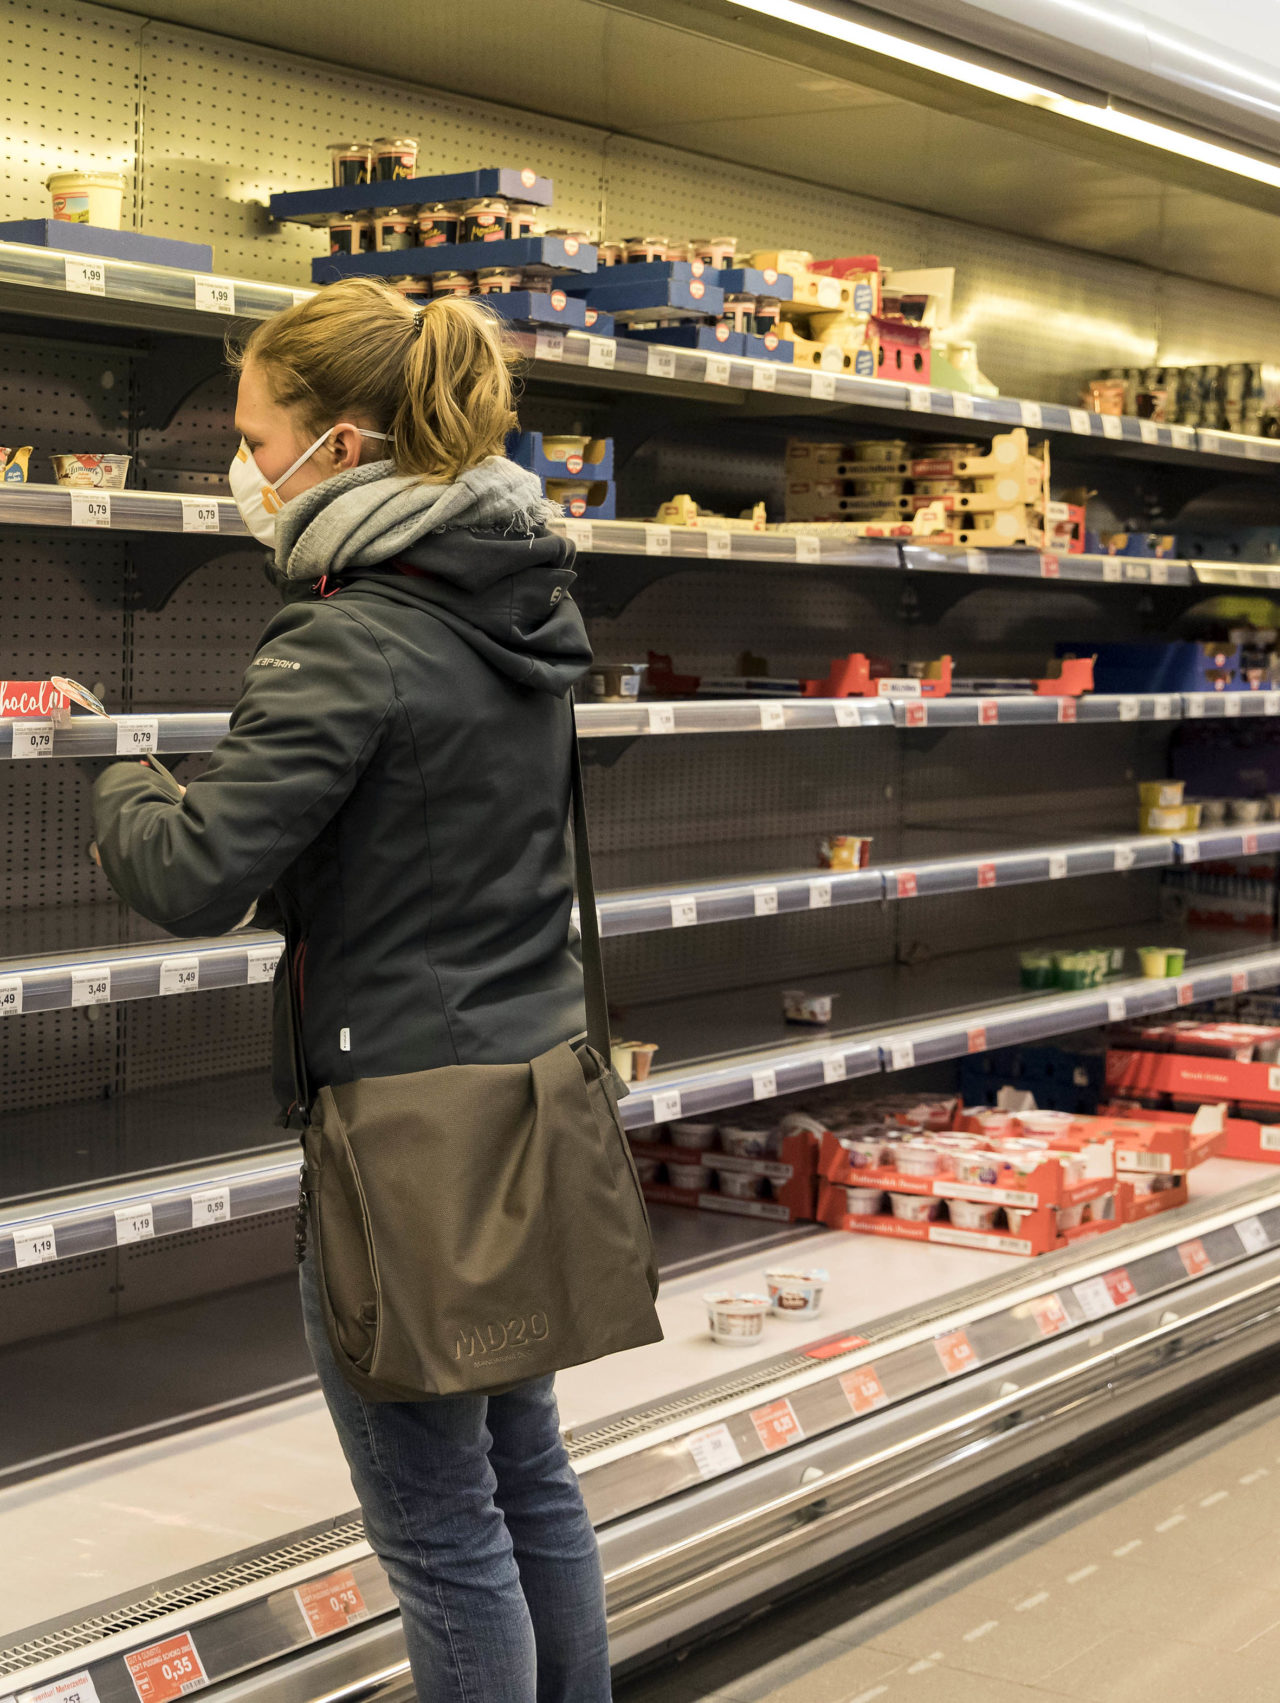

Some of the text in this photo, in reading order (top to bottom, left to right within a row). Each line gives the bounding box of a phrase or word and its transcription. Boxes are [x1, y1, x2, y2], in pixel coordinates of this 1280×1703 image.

[82, 268, 101, 282] 1,99
[211, 290, 228, 303] 1,99
[88, 504, 107, 516] 0,79
[198, 509, 216, 521] 0,79
[30, 735, 50, 750] 0,79
[133, 731, 151, 746] 0,79
[178, 972, 196, 984] 3,49
[88, 982, 107, 996] 3,49
[207, 1201, 224, 1213] 0,59
[132, 1219, 150, 1232] 1,19
[32, 1240, 52, 1254] 1,19
[456, 1312, 549, 1359] MD20
[131, 1648, 180, 1672] SOFT PUDDING SCHOKO
[162, 1656, 193, 1681] 0,35
